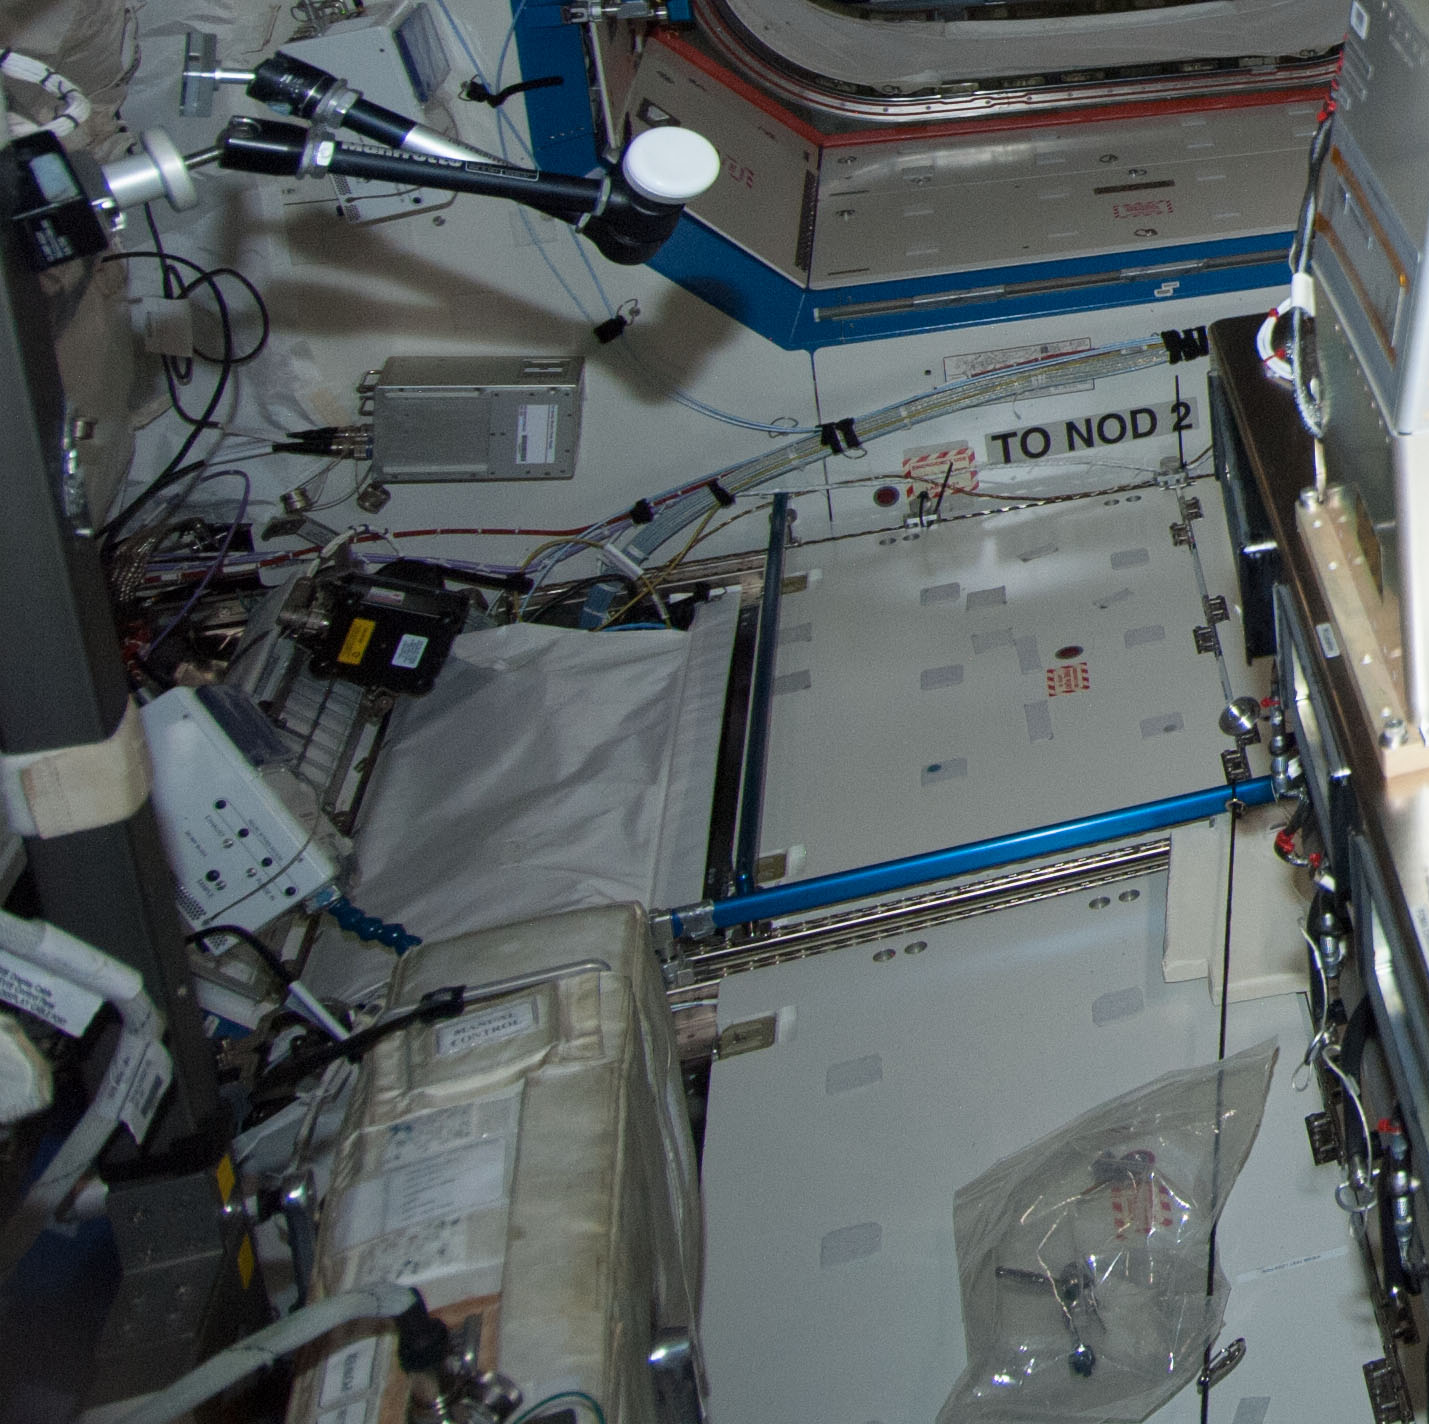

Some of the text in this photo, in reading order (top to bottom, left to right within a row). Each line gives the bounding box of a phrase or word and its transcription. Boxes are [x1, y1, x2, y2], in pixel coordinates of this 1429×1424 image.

[341, 140, 463, 168] Manfrotto
[991, 401, 1193, 464] TO NOD 2
[450, 1019, 519, 1048] CONTROL
[453, 1012, 513, 1036] MANUAL
